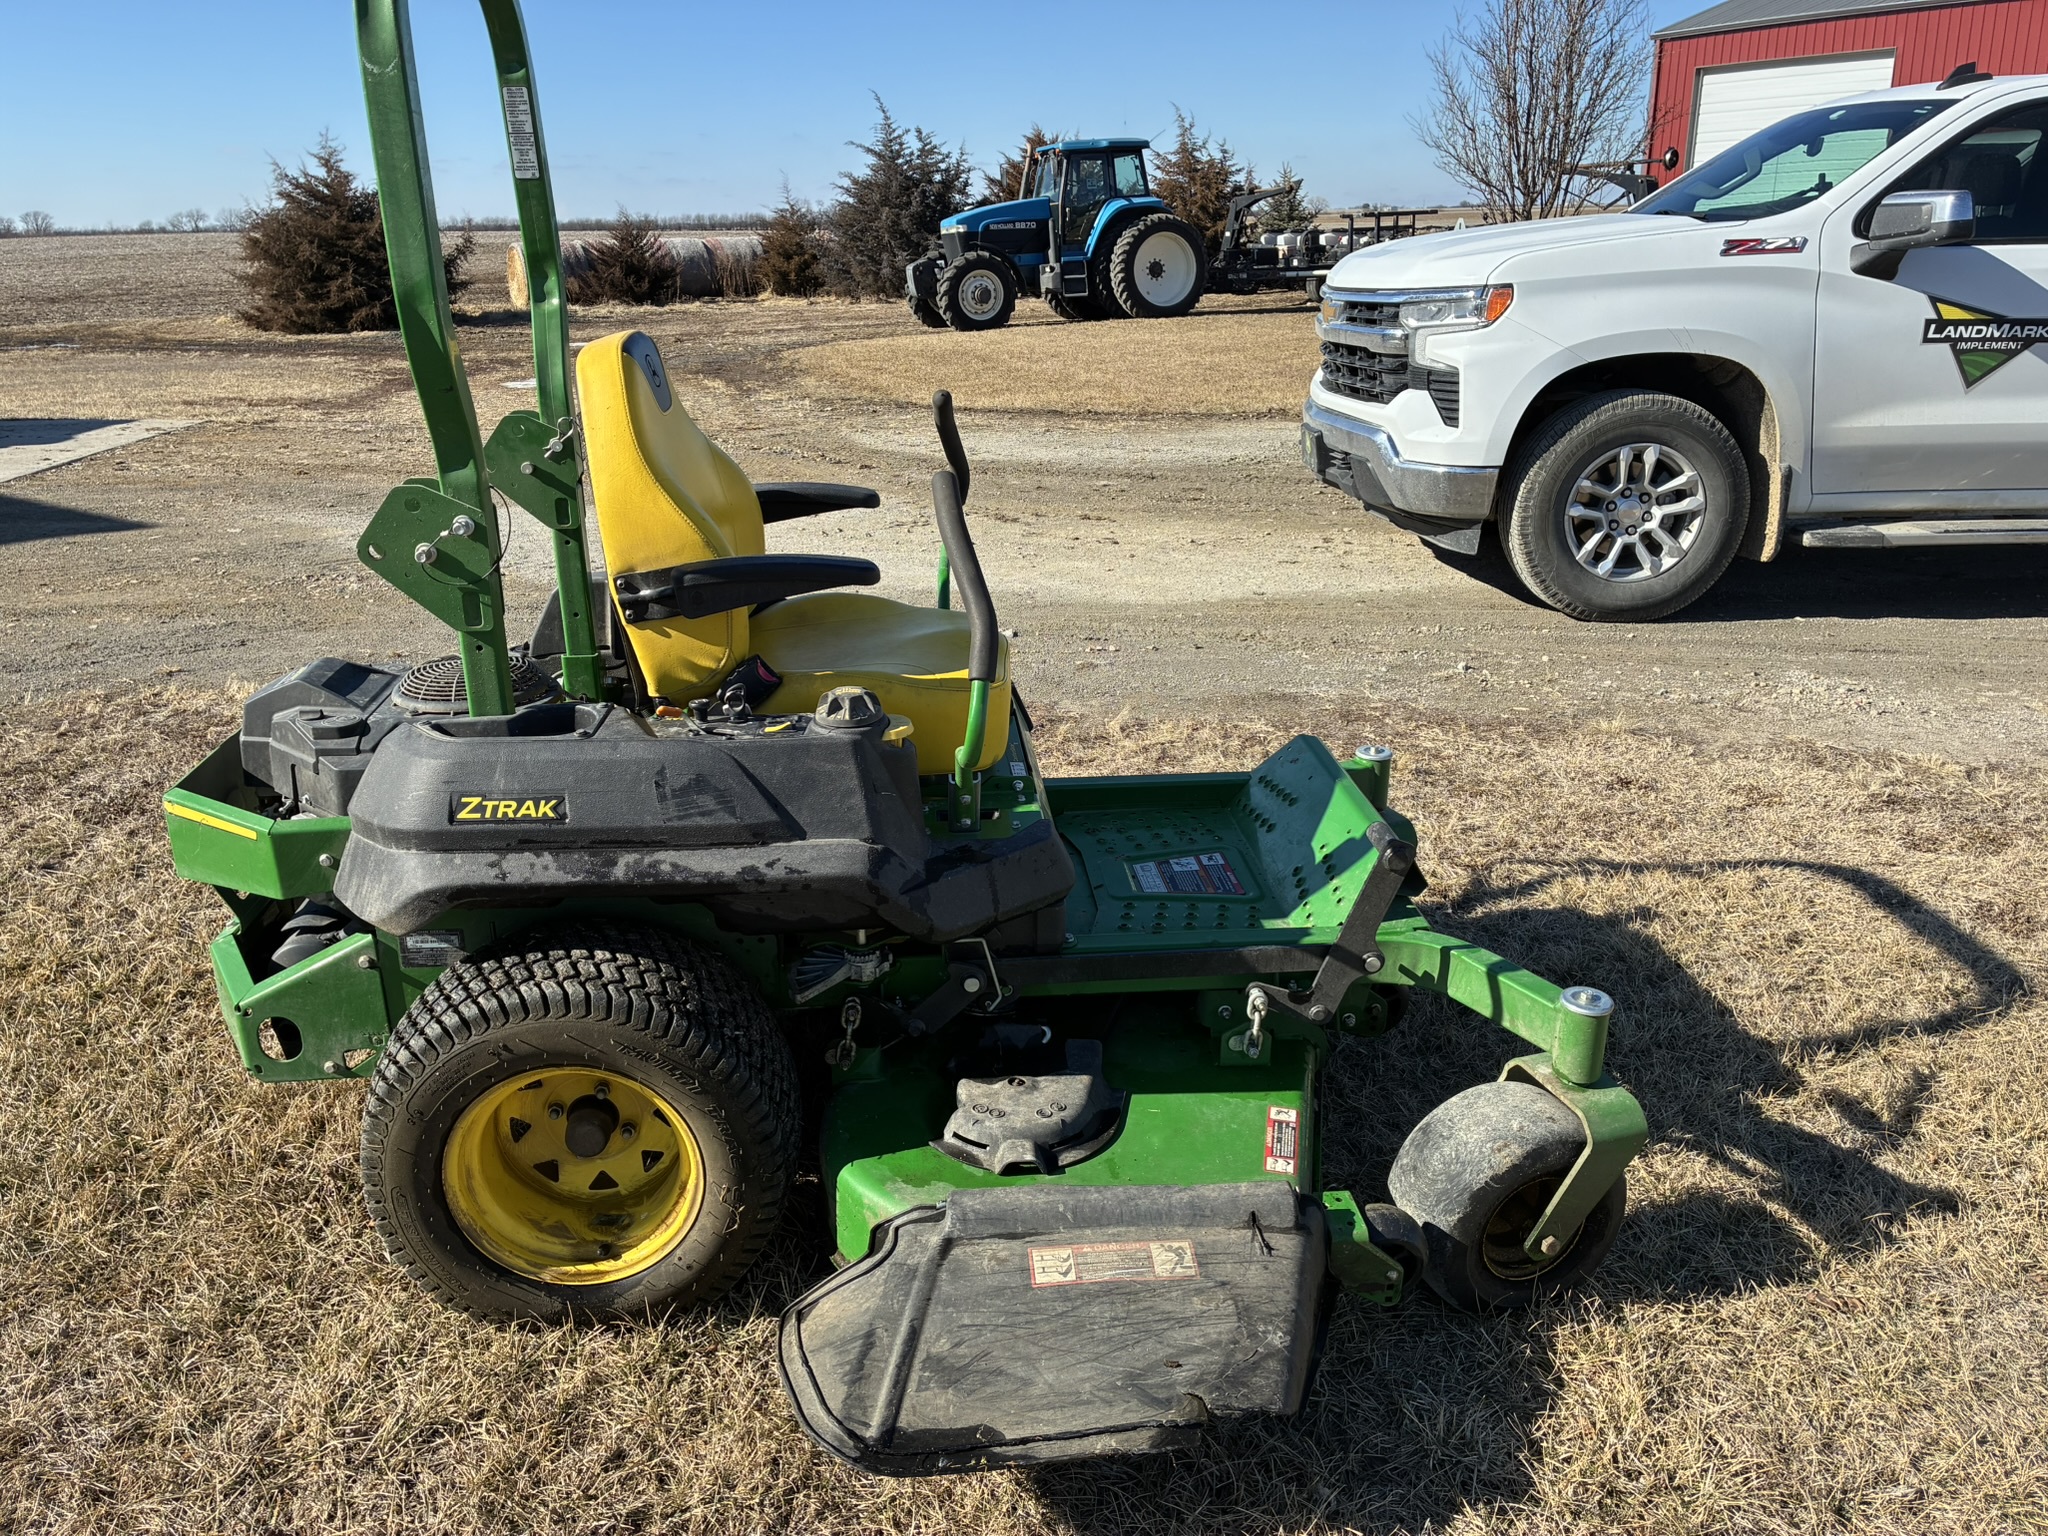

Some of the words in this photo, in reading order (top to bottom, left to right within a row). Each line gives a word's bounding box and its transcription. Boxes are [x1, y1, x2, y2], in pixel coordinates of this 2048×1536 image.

[1719, 236, 1808, 257] Z71
[1927, 323, 2048, 338] LANDMARK
[1956, 341, 2024, 350] IMPLEMENT
[456, 797, 558, 819] ZTRAK
[1094, 1242, 1142, 1252] DANGER
